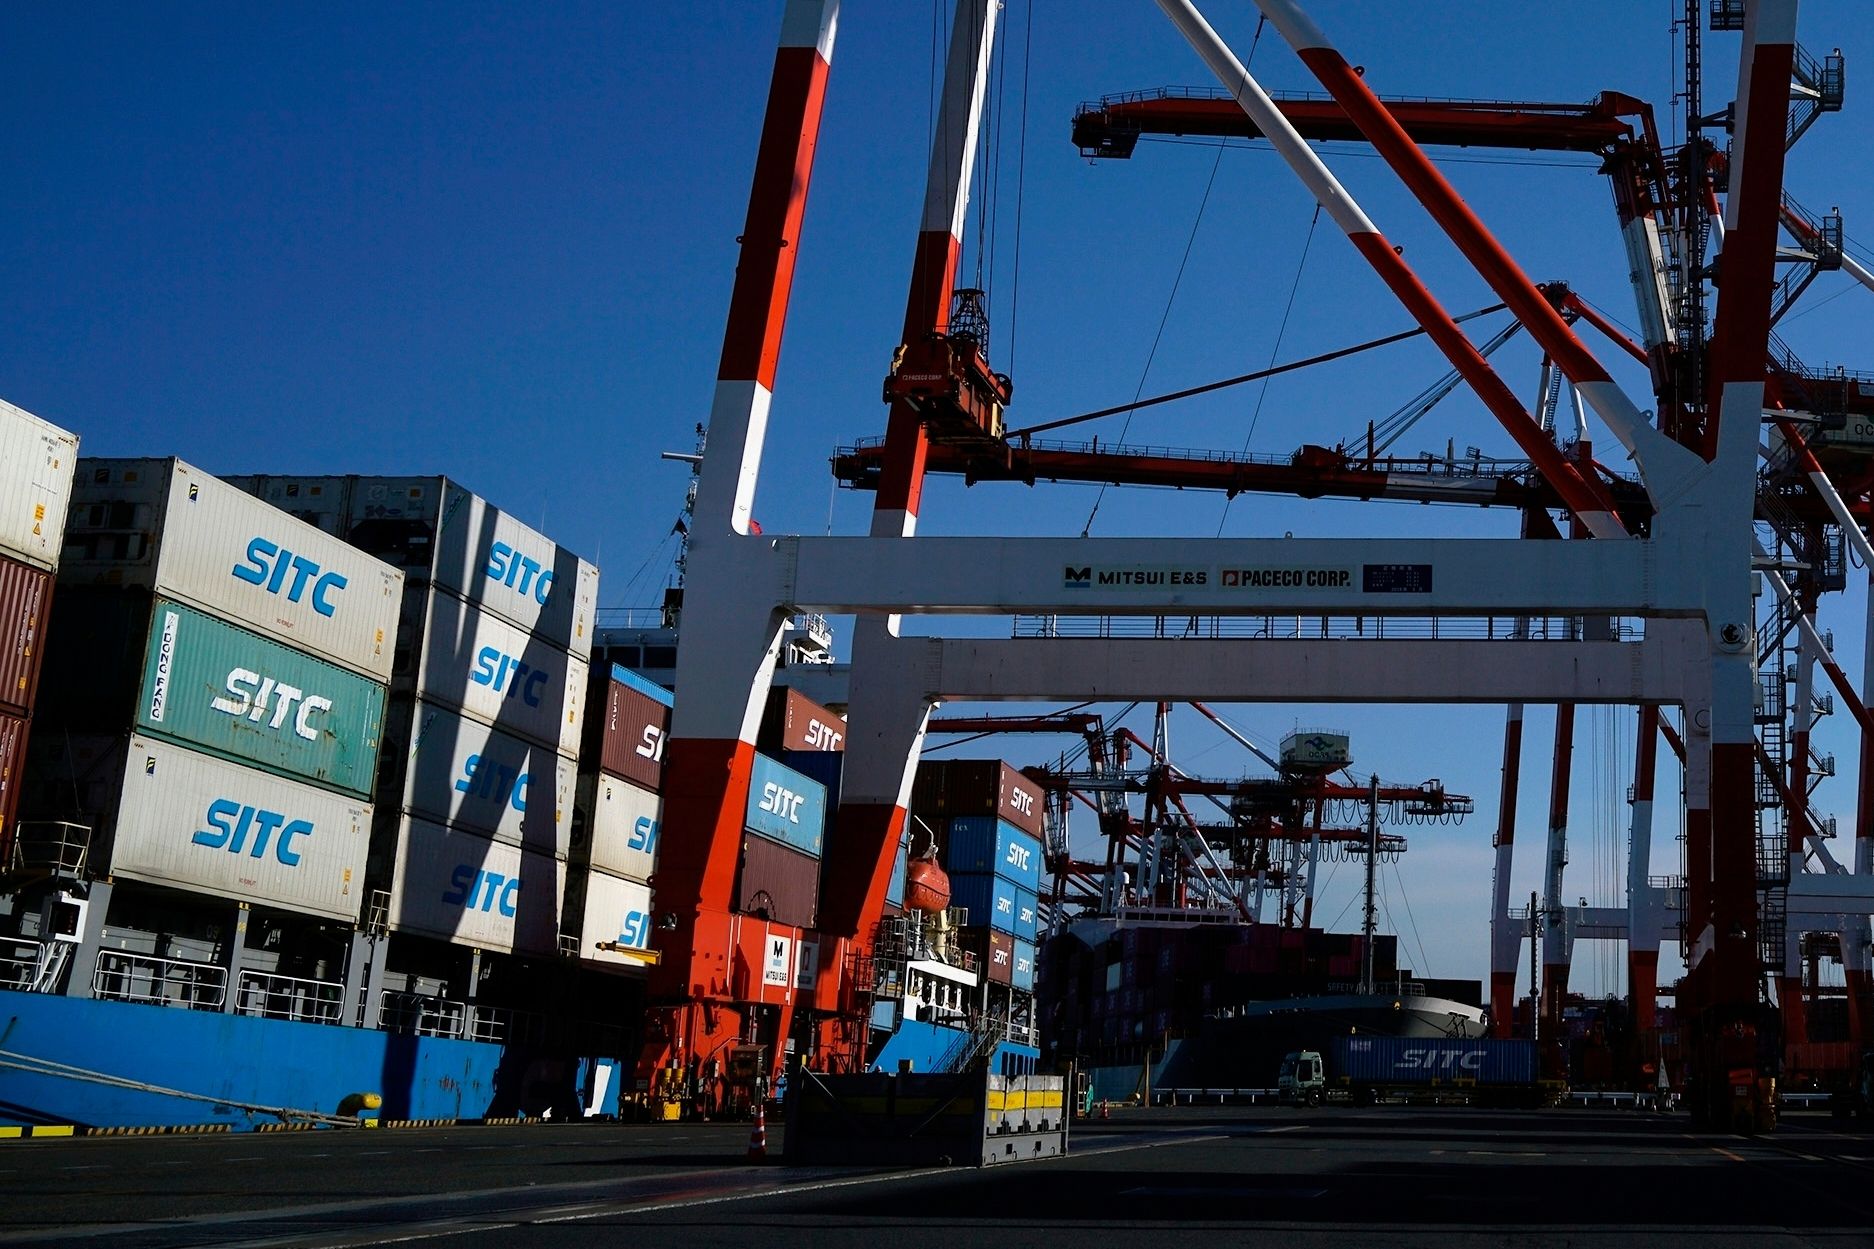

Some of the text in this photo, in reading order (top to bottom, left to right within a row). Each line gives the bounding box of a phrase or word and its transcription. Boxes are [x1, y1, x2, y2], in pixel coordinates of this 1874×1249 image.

[231, 536, 348, 618] SITC
[482, 541, 559, 607] SITC
[1098, 571, 1208, 585] MITSUI E&S
[1241, 569, 1304, 587] PACECO
[1306, 569, 1351, 587] CORP.
[152, 632, 172, 719] DONG FANG
[470, 646, 549, 708] SITC
[210, 667, 333, 741] SITC
[636, 724, 668, 763] SI
[804, 718, 843, 752] SITC
[454, 754, 536, 813] SITC
[758, 781, 805, 824] SITC
[1010, 786, 1034, 817] SITC
[192, 798, 314, 867] SITC
[627, 815, 661, 854] SI
[1006, 842, 1031, 872] SITC
[442, 863, 523, 918] SITC
[619, 910, 651, 948] SI
[993, 949, 1009, 966] SITC
[1394, 1049, 1488, 1069] SITC
